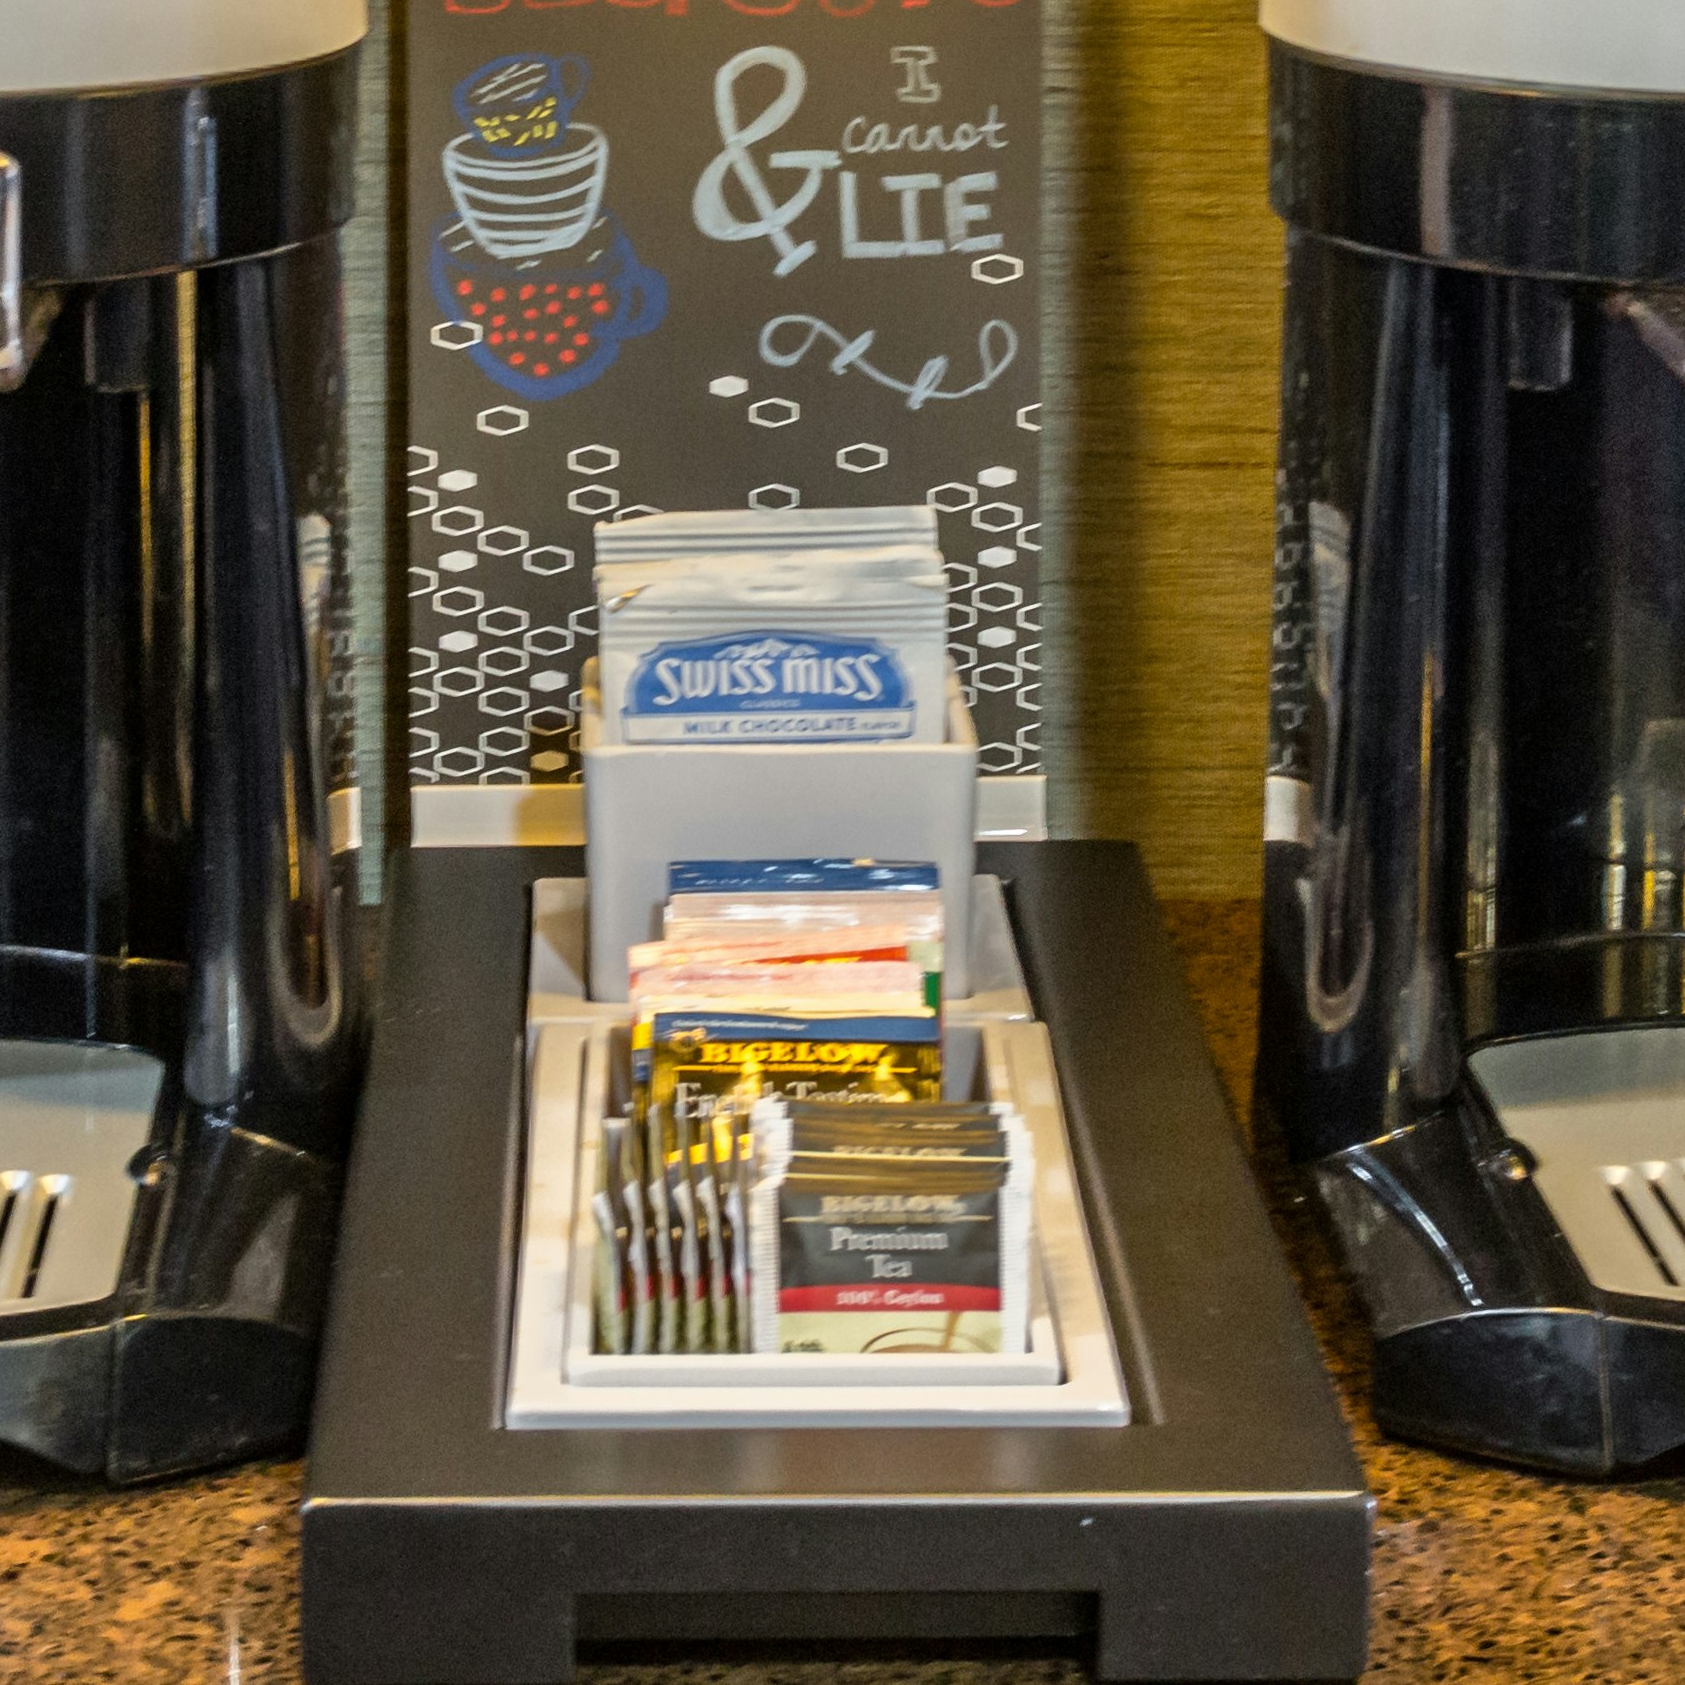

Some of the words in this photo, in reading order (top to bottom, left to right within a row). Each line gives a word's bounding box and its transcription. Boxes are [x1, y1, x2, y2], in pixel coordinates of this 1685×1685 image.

[890, 45, 942, 104] I
[692, 44, 842, 277] &
[838, 171, 1004, 259] LIE
[683, 720, 731, 734] MILK
[739, 717, 856, 734] CHOCOLATE
[700, 1042, 889, 1064] BIGELOW
[829, 1226, 949, 1251] Premium
[865, 1254, 913, 1278] Tea
